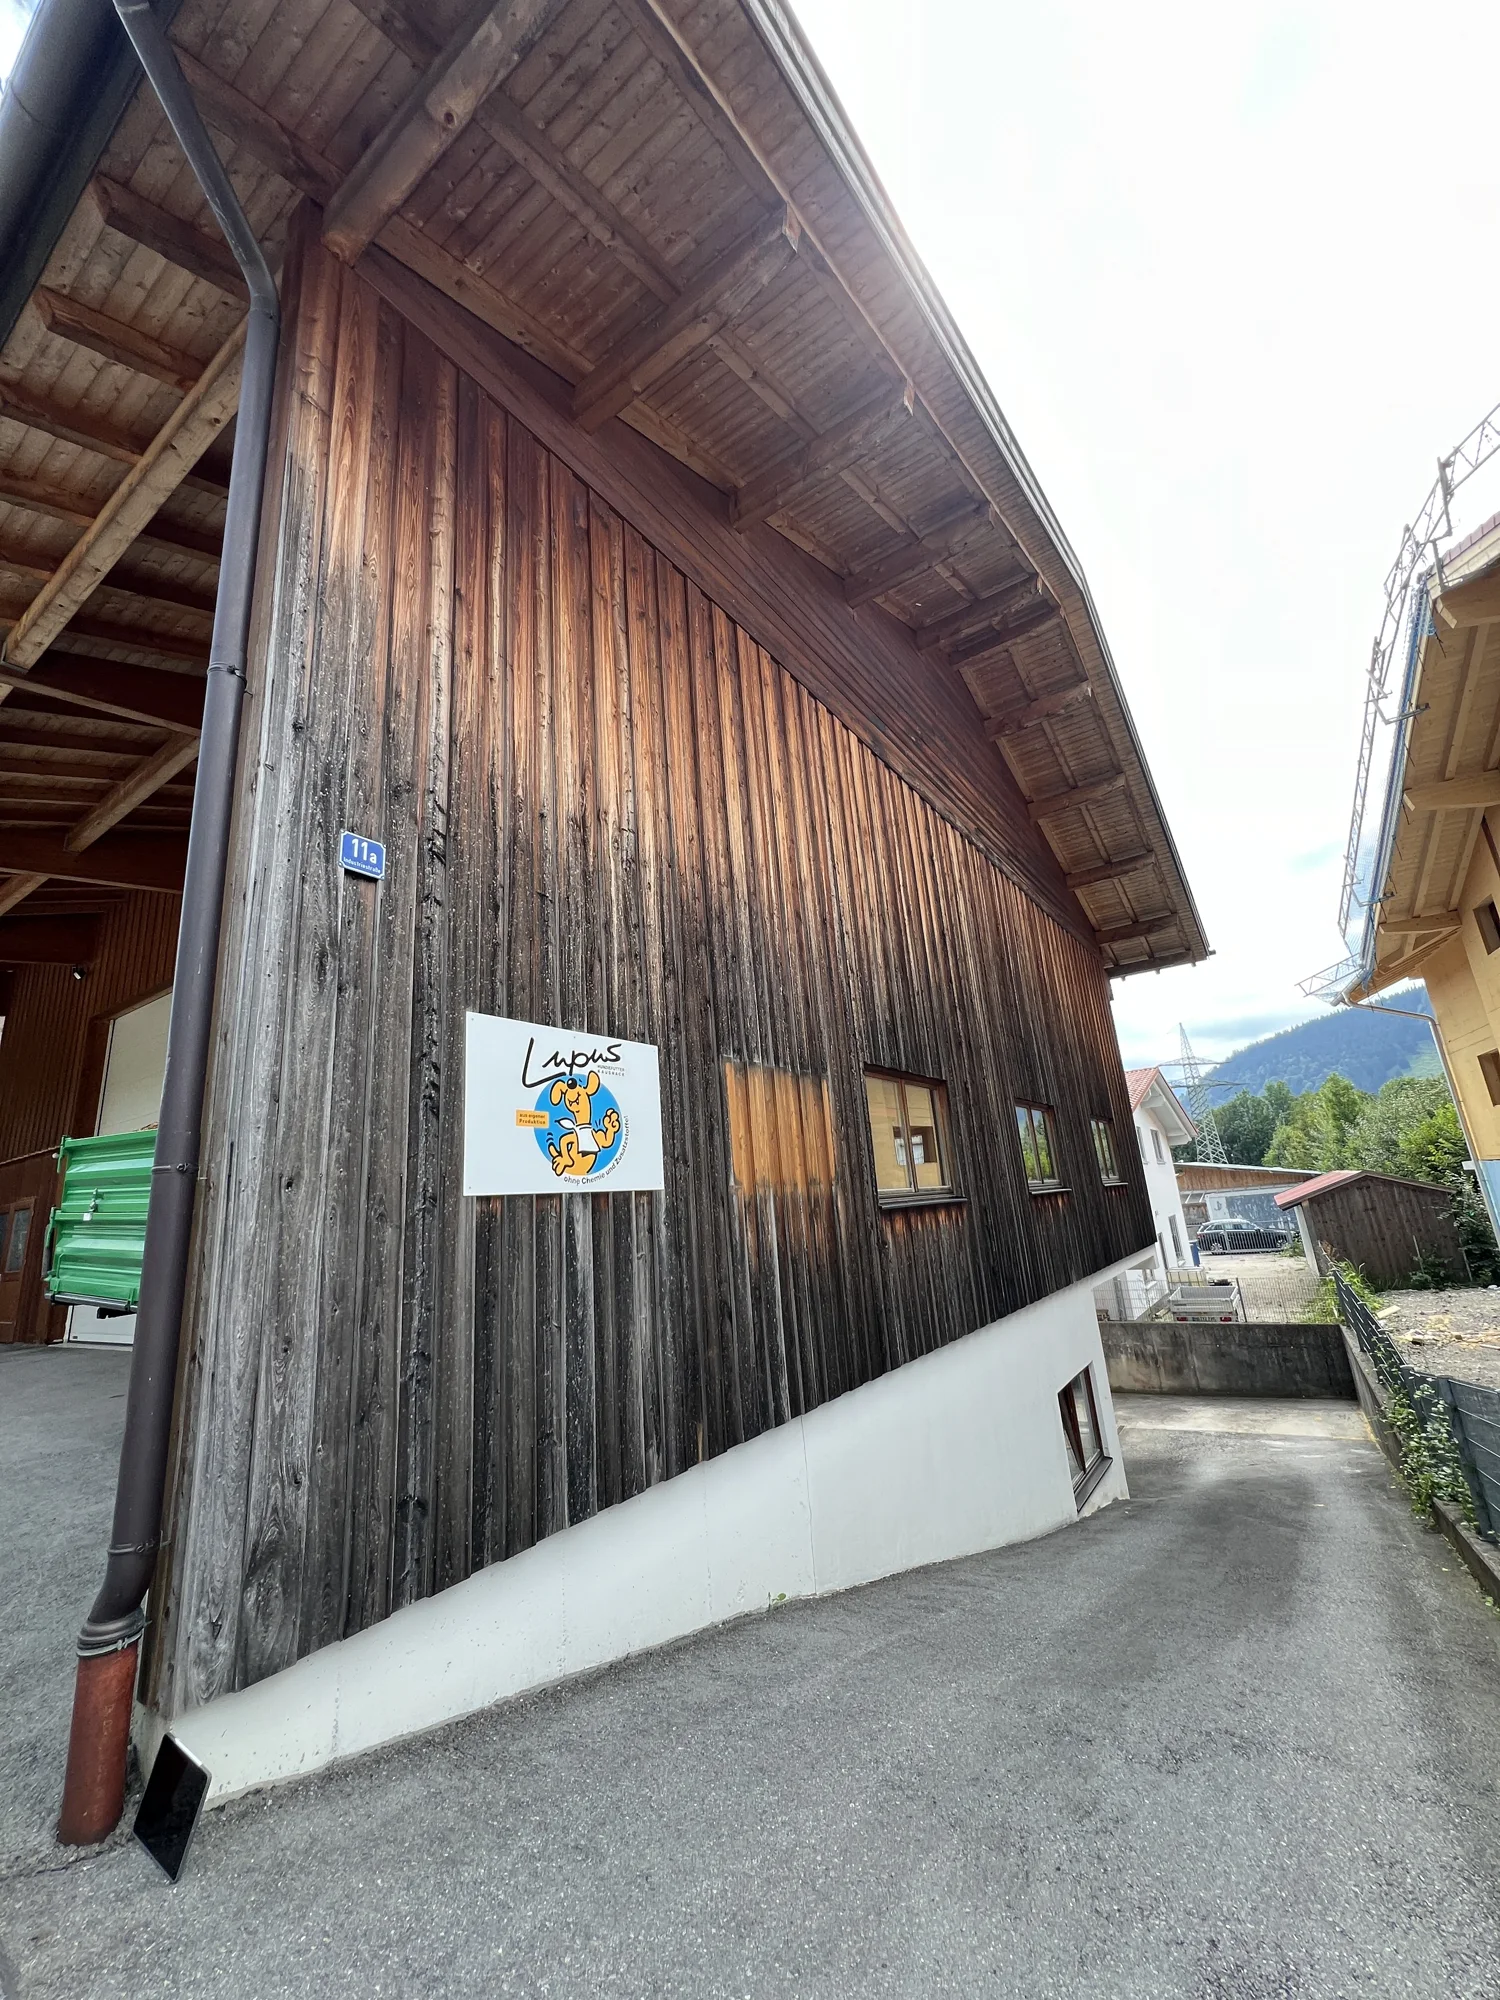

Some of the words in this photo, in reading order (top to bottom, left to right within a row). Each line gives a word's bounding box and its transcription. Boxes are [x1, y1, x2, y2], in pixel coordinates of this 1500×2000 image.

[351, 838, 377, 864] 11a
[522, 1037, 622, 1087] Lupus
[581, 1171, 605, 1184] Chemie
[605, 1162, 616, 1175] und
